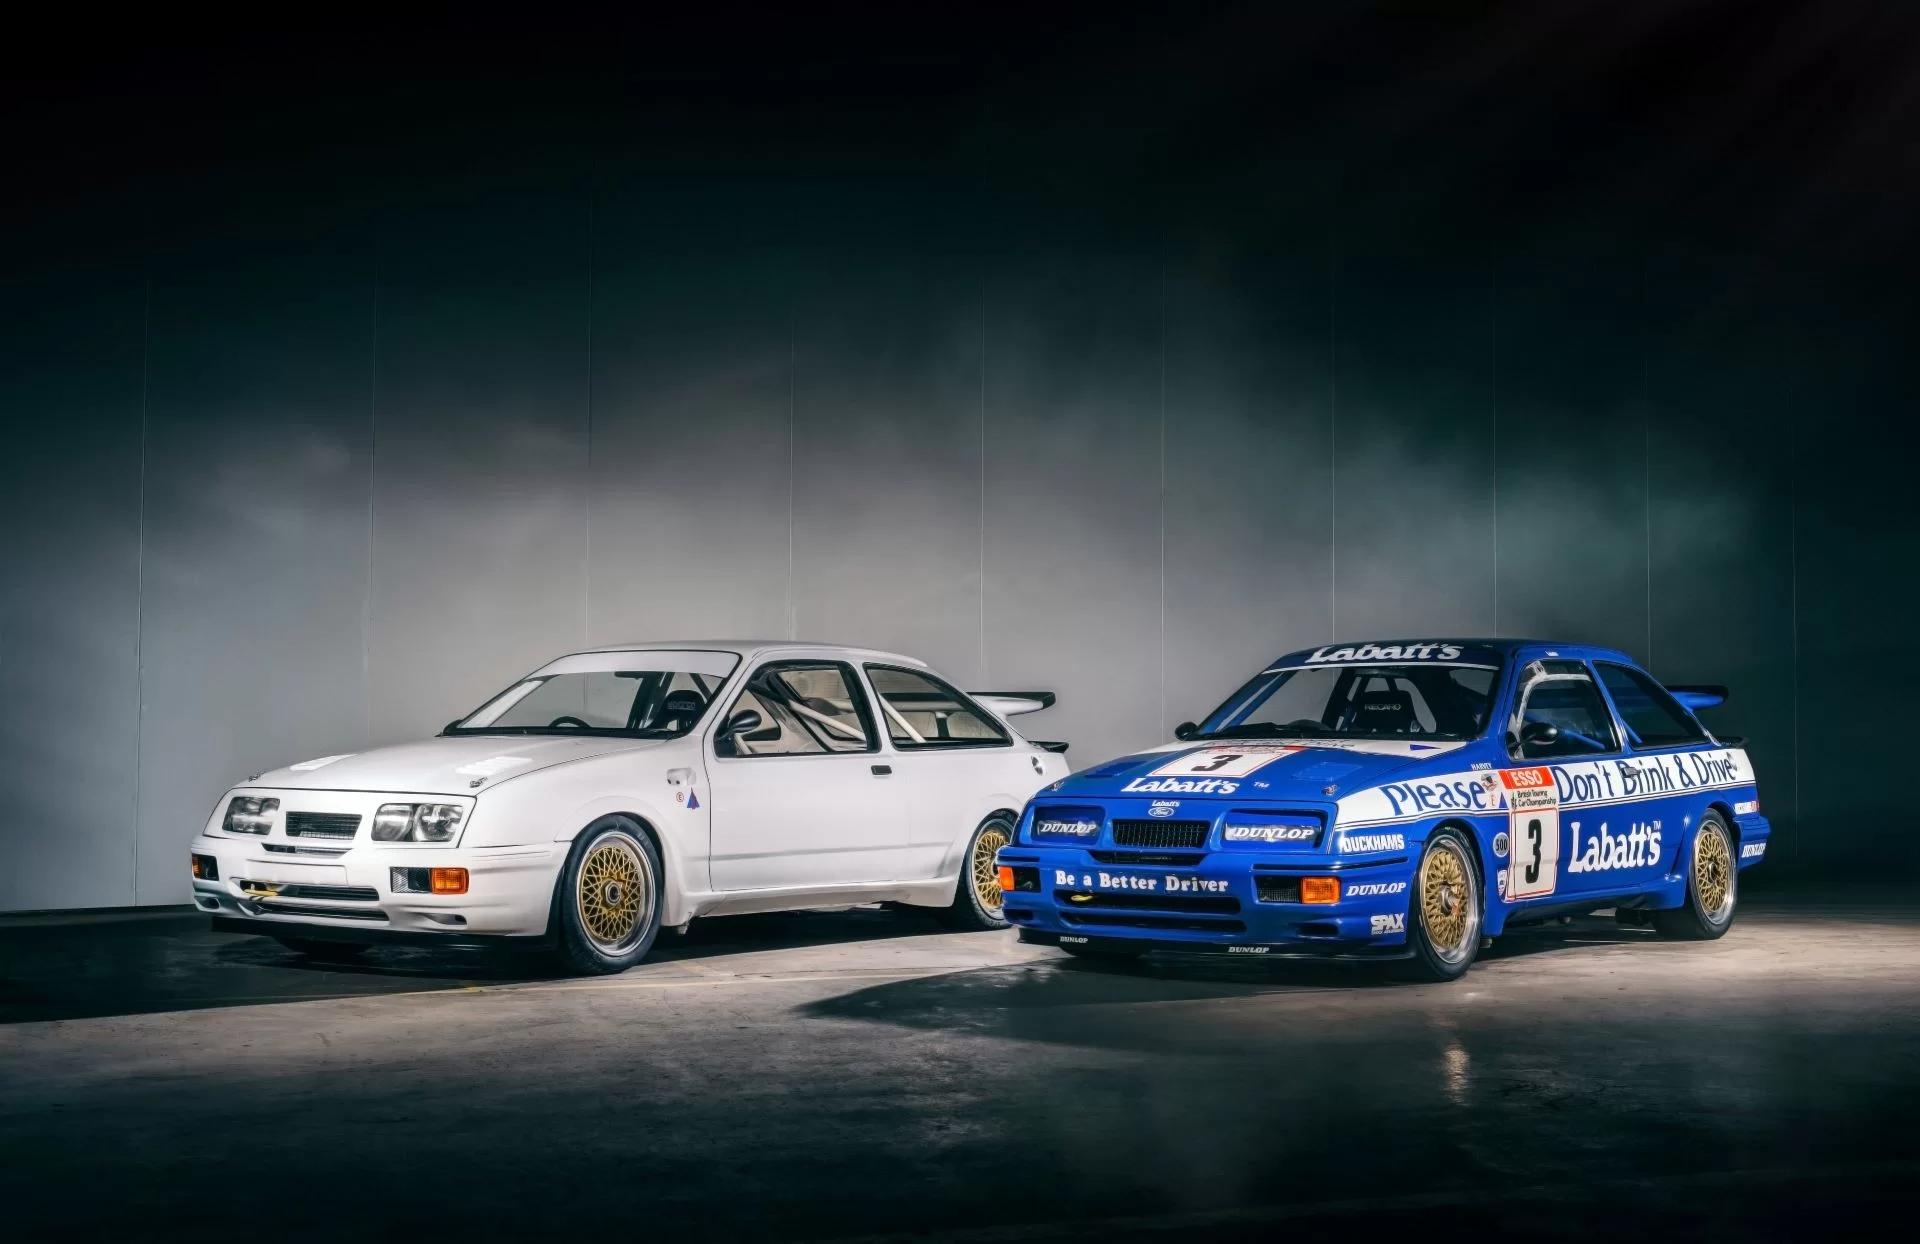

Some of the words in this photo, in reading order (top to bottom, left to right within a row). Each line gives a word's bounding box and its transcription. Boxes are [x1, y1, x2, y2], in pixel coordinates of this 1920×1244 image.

[1305, 643, 1464, 663] Labatt's
[1364, 703, 1402, 711] RECARO
[1190, 754, 1243, 772] 3
[1121, 777, 1240, 794] Labatt's
[1511, 769, 1543, 787] ESSO
[1551, 760, 1614, 802] Don't
[1674, 754, 1696, 788] &
[1690, 752, 1737, 785] Drive
[1152, 800, 1180, 808] Labatt's
[1379, 781, 1486, 816] Please
[1040, 822, 1097, 834] DUNLOP
[1233, 827, 1315, 839] DUNLOP
[1341, 834, 1405, 852] DUCKHAMS
[1525, 819, 1542, 884] 3
[1568, 821, 1662, 873] Labatt's
[1056, 870, 1075, 886] Be
[1083, 874, 1092, 887] a
[1099, 872, 1157, 890] Better
[1165, 875, 1229, 892] Driver
[1346, 882, 1407, 896] DUNLOP
[1370, 912, 1405, 931] SPAX
[1059, 935, 1089, 944] DUNLOP
[1227, 945, 1270, 953] DUNLOP
